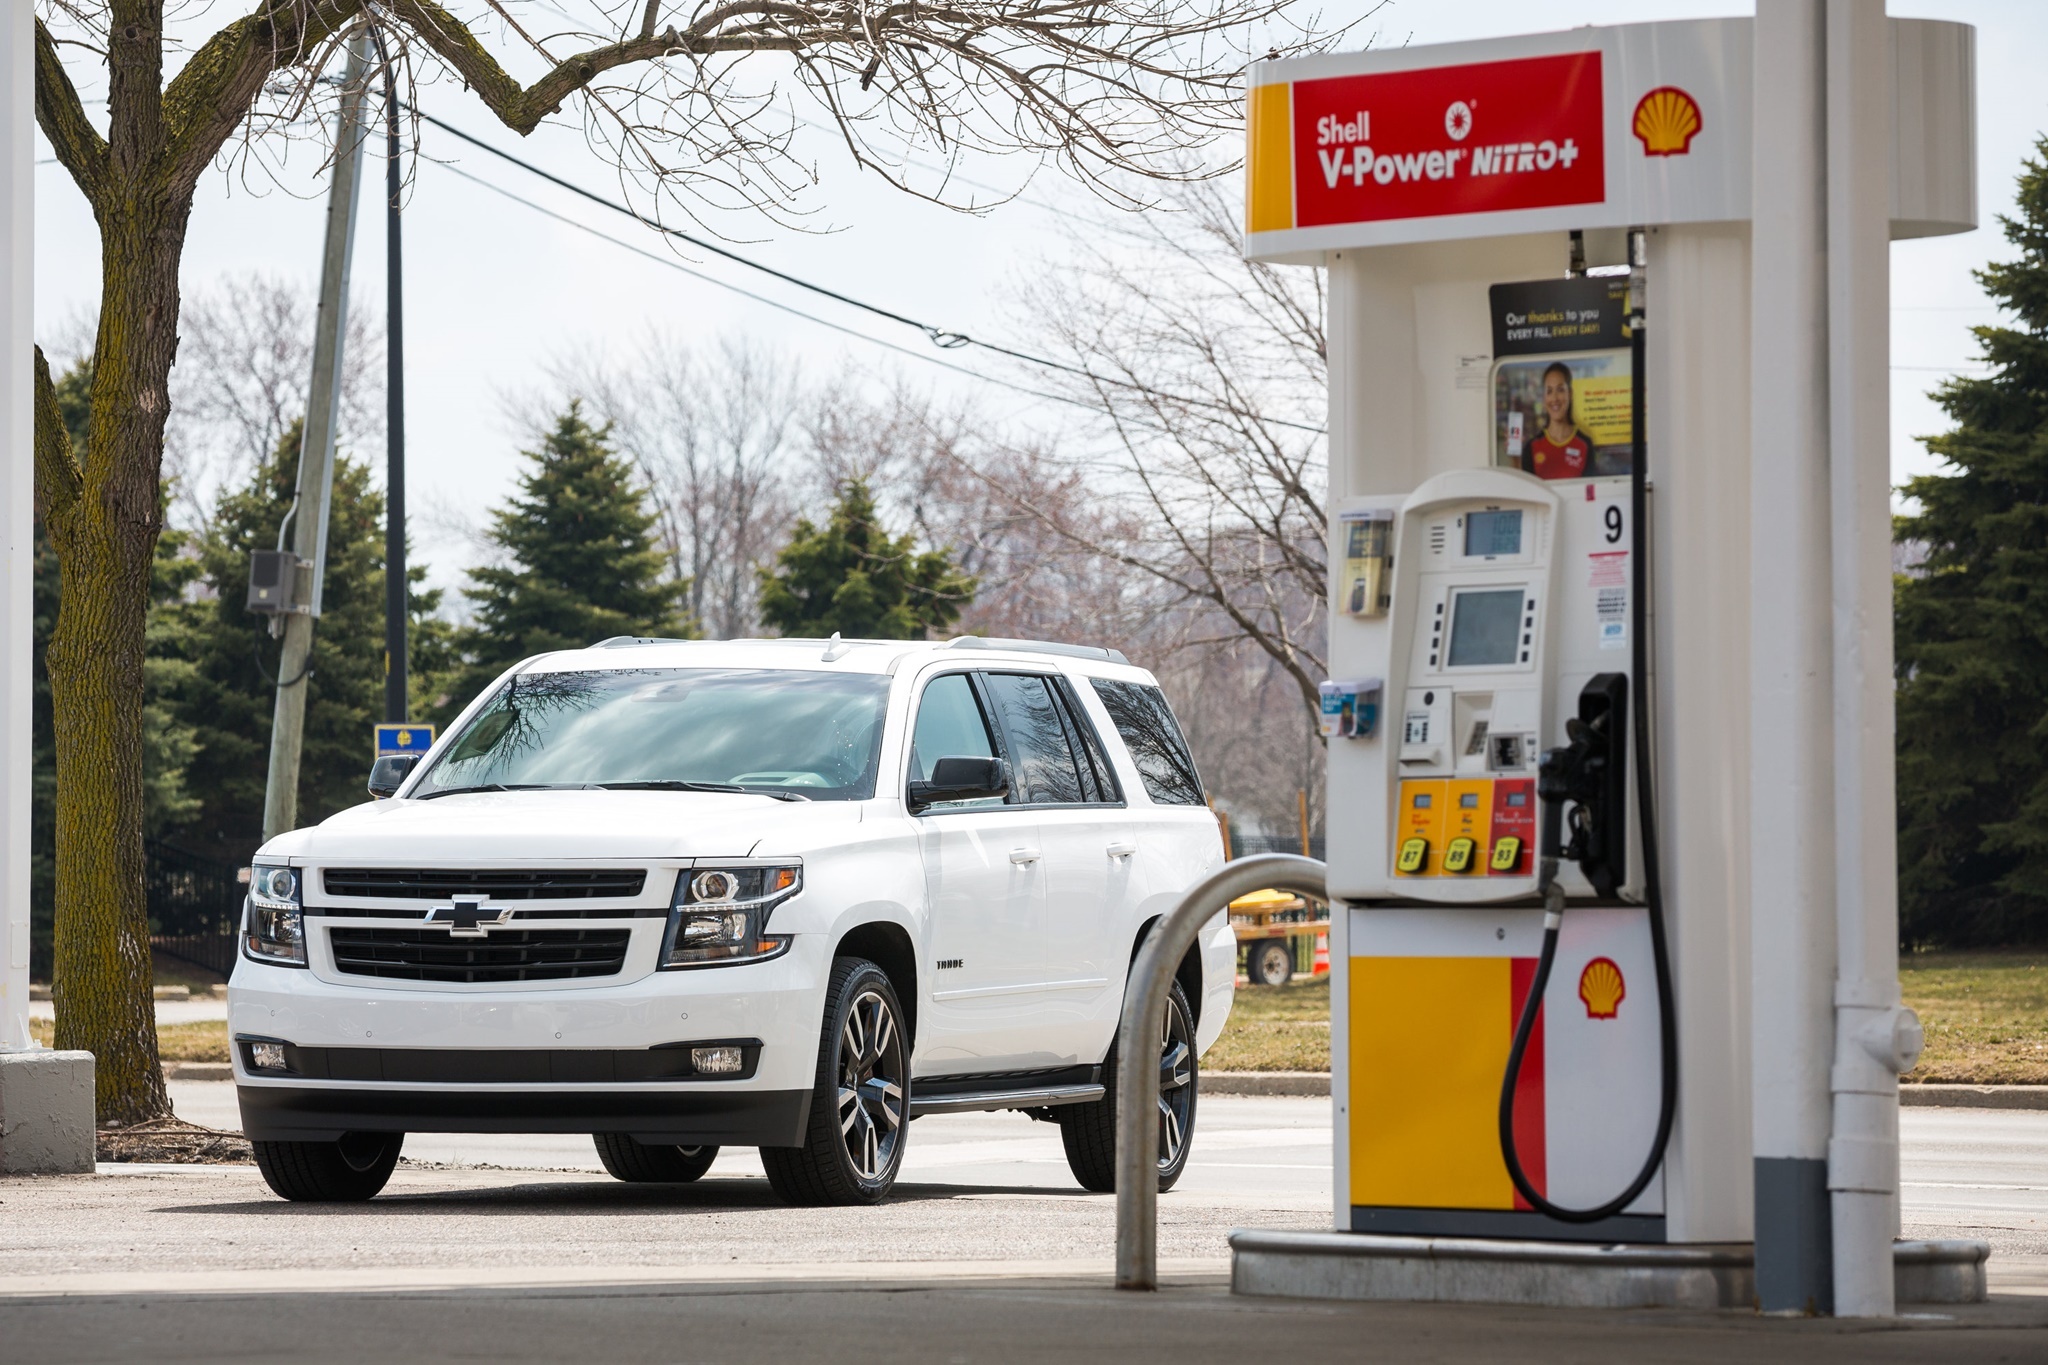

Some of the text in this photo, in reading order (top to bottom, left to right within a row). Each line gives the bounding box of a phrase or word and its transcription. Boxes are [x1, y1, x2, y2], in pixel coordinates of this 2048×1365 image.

[1317, 110, 1370, 146] Shell
[1317, 145, 1461, 189] V-Power
[1506, 307, 1600, 326] Our thanks to you
[1506, 328, 1533, 341] EVERY
[1552, 325, 1578, 337] EVERY
[1604, 505, 1623, 544] 9
[1403, 850, 1418, 863] 87
[1449, 850, 1465, 863] 89
[1497, 849, 1512, 862] 93
